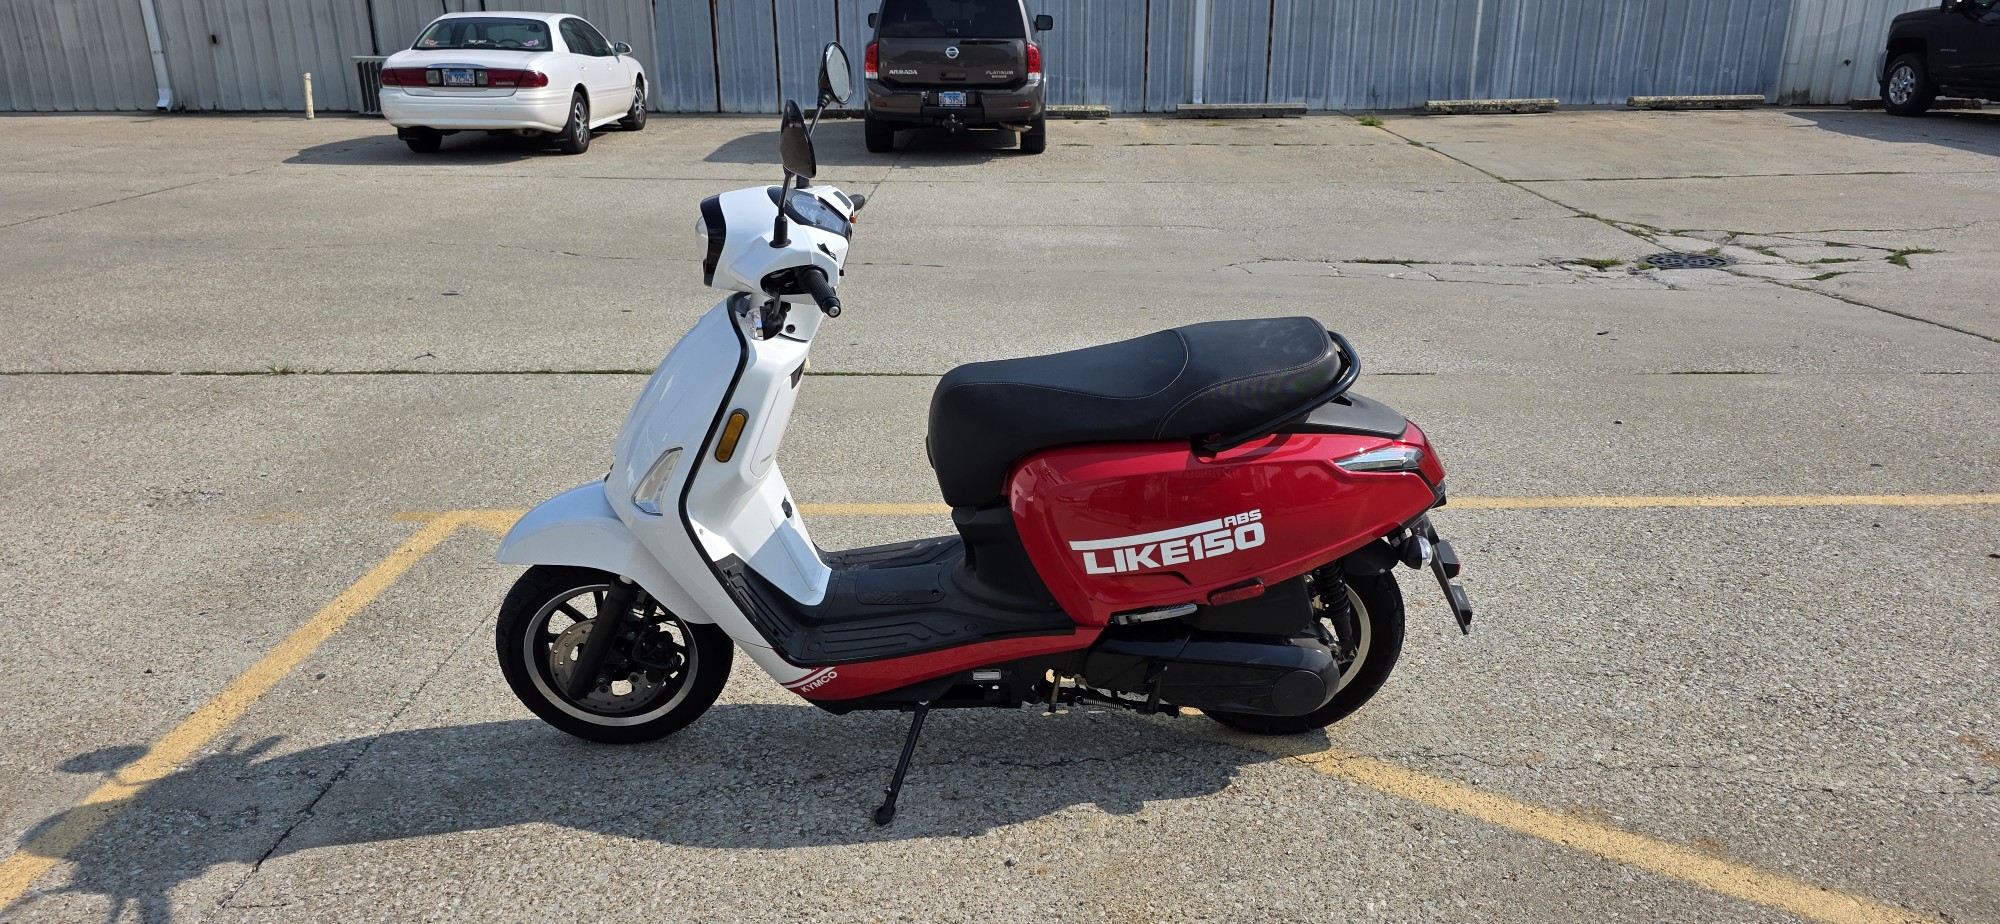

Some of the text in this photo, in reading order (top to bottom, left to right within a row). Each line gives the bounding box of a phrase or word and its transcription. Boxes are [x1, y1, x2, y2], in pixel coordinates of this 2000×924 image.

[1224, 508, 1262, 528] ABS
[1082, 521, 1266, 575] LIKE150
[800, 671, 838, 693] KYMCO
